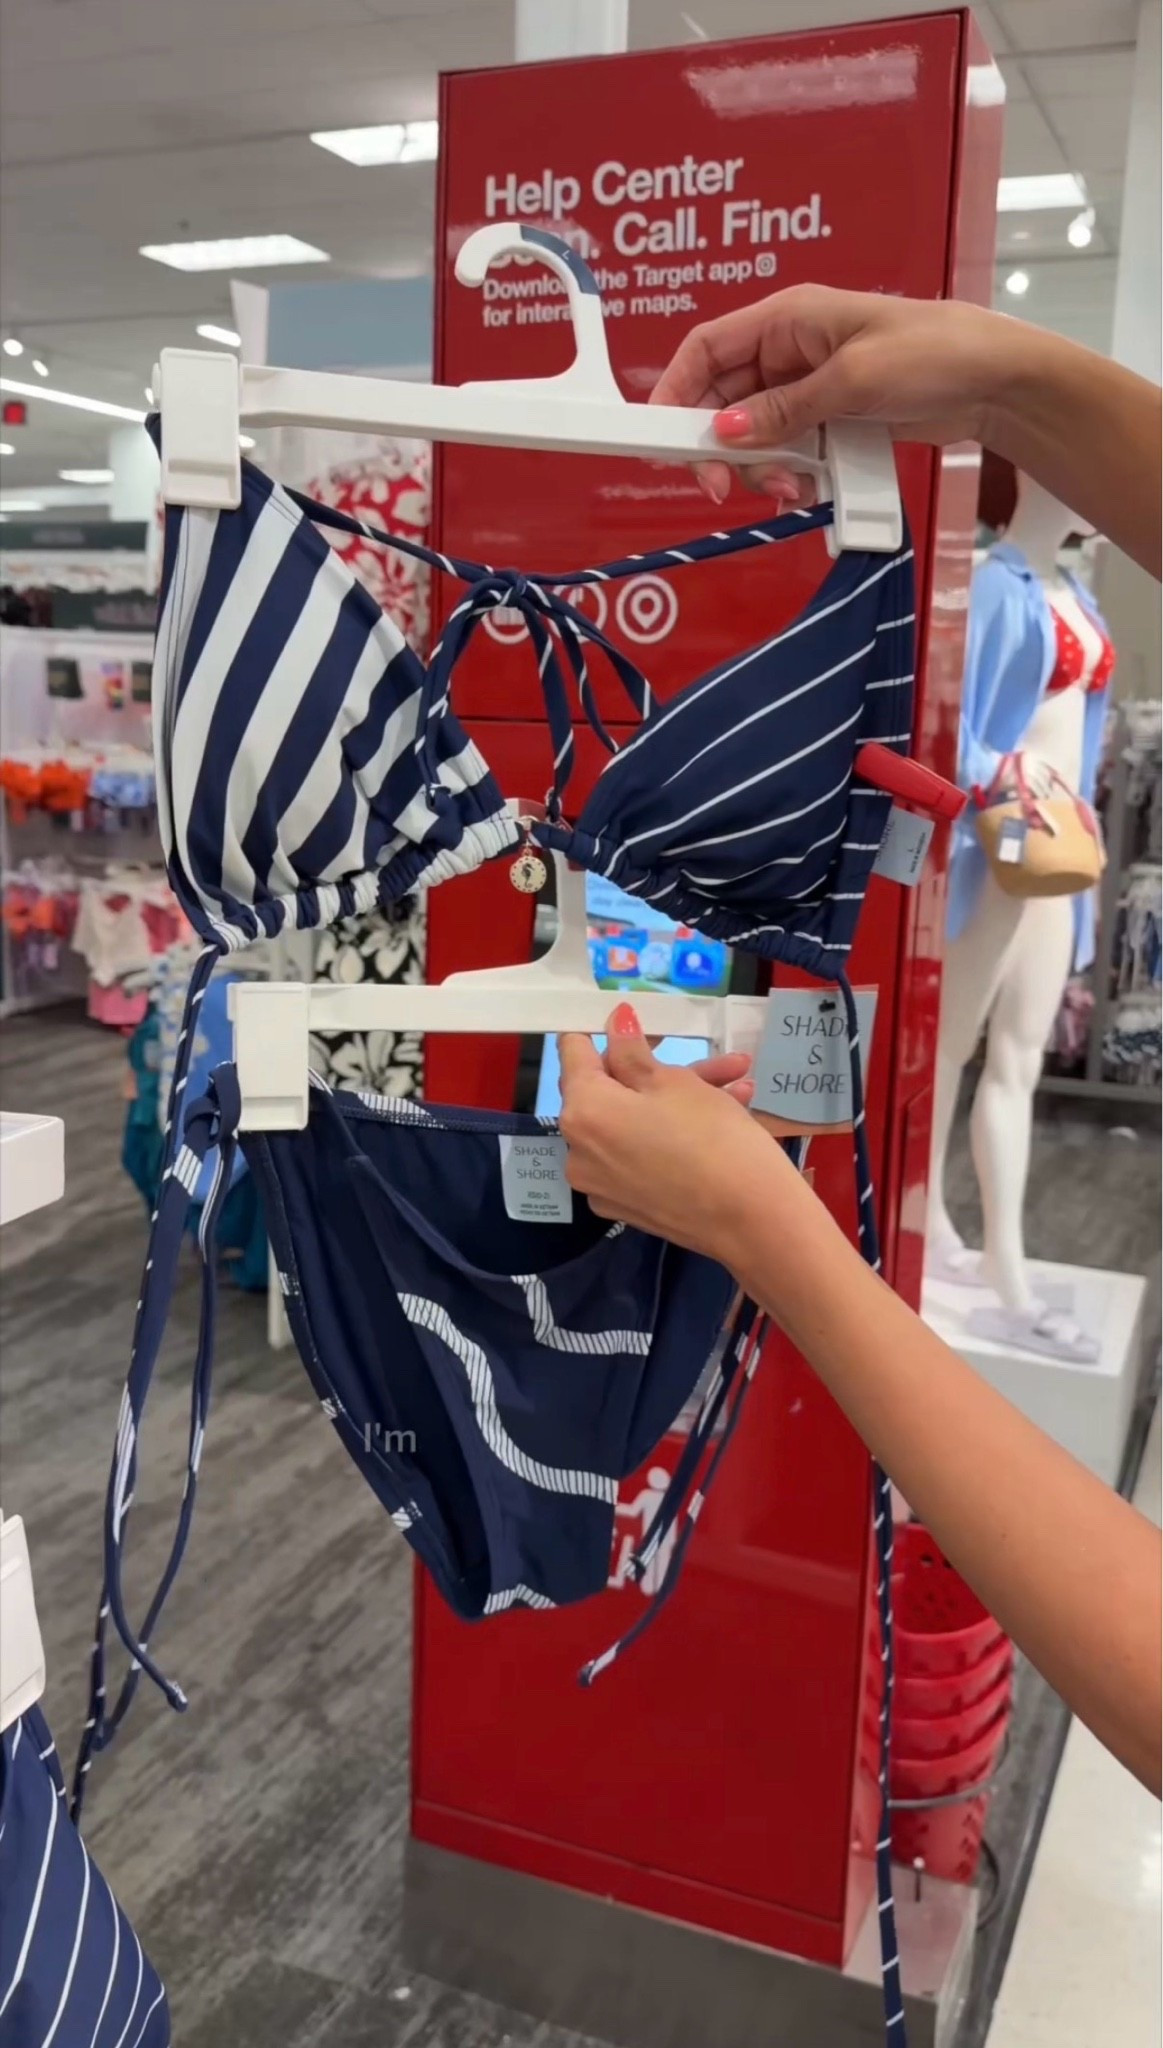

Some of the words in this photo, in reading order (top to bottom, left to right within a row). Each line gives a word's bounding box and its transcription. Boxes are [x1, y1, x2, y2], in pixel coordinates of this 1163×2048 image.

[485, 169, 581, 220] Help
[592, 155, 744, 206] Center
[613, 206, 707, 256] Call.
[722, 193, 832, 247] Find.
[483, 272, 569, 300] Downlo
[633, 260, 704, 290] Target
[708, 260, 753, 285] app
[483, 304, 512, 328] for
[515, 301, 625, 325] interave
[630, 293, 698, 318] maps.
[780, 1015, 849, 1037] SHAD
[807, 1044, 823, 1065] &
[770, 1072, 849, 1094] SHORE
[514, 1145, 557, 1157] SHADE
[532, 1156, 542, 1167] &
[516, 1168, 560, 1181] SHORE
